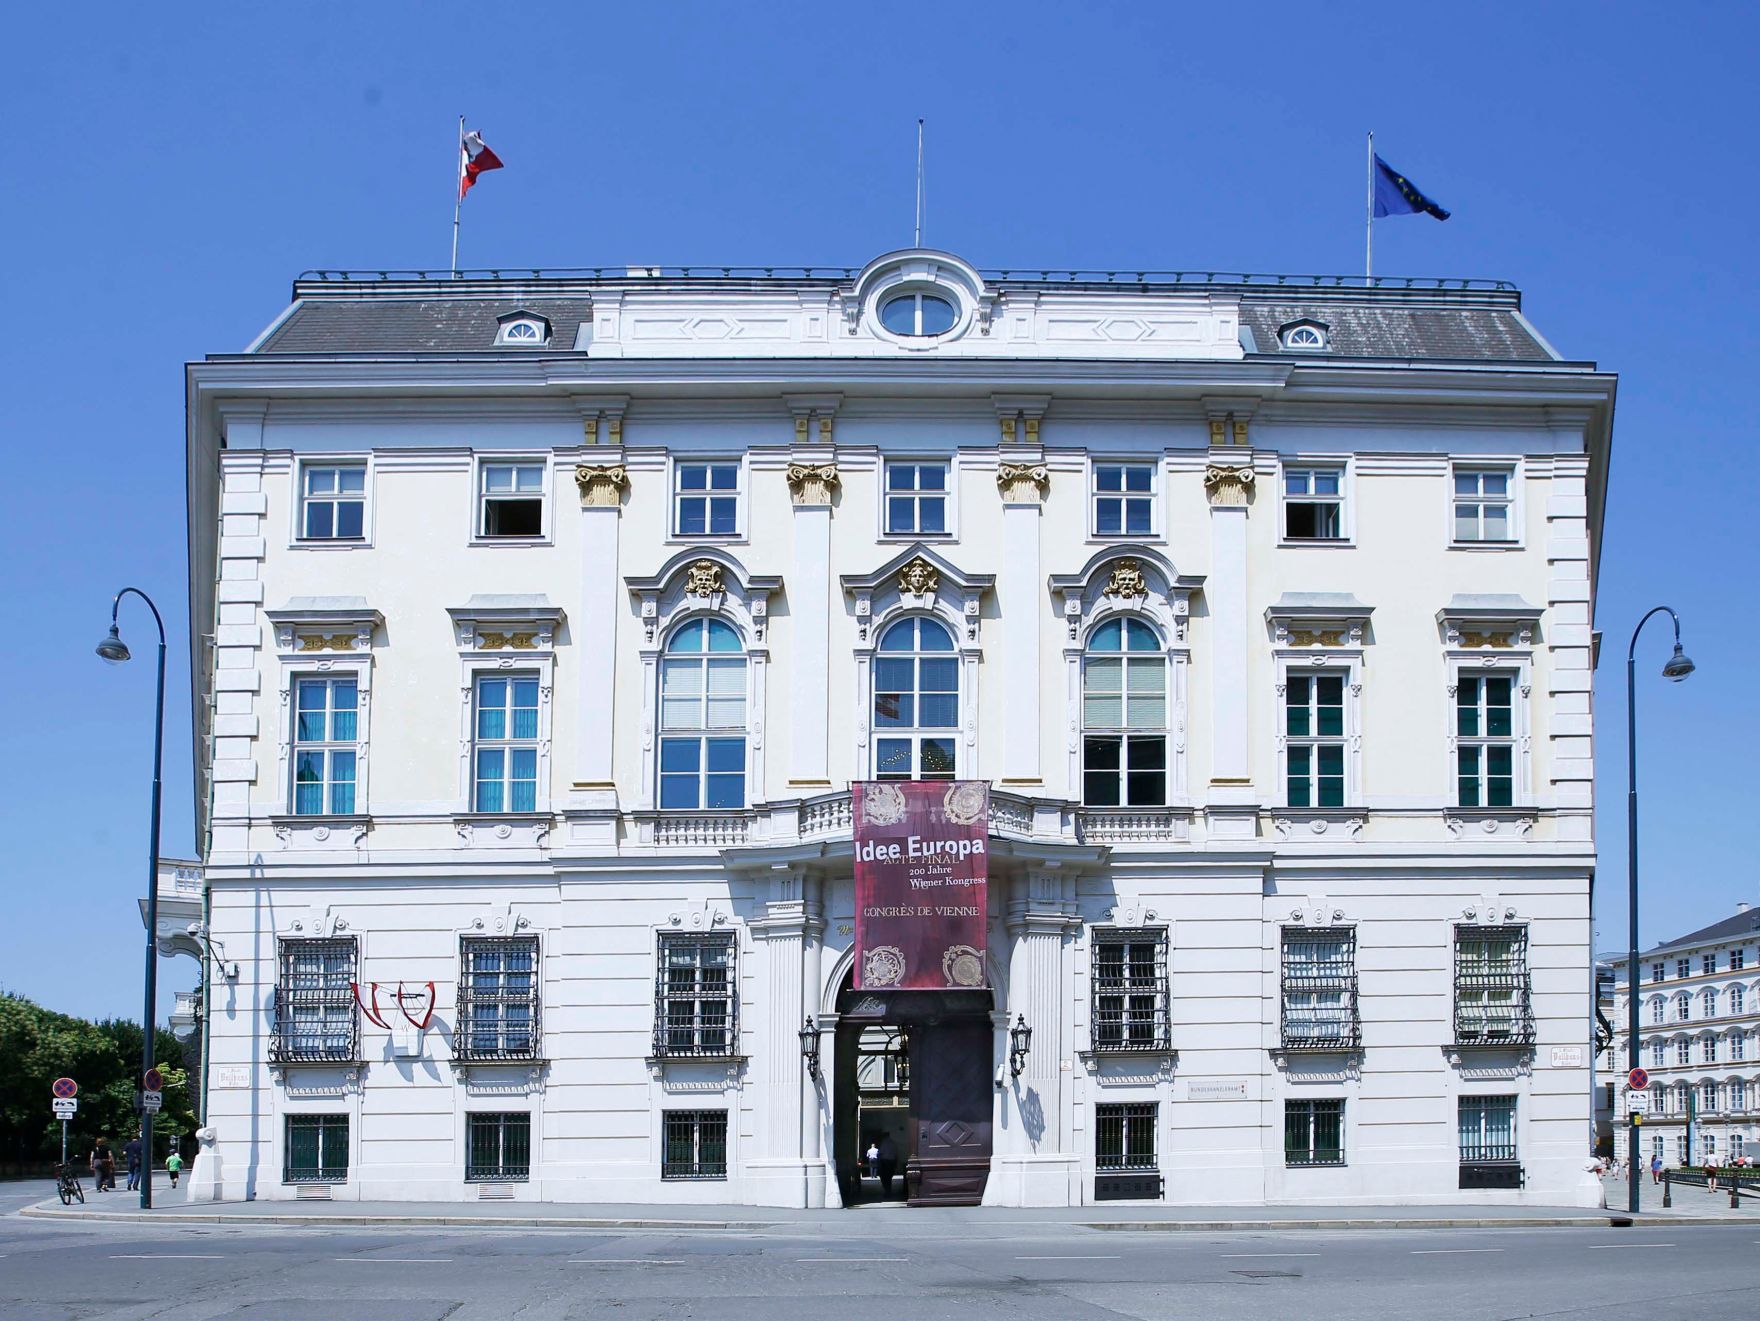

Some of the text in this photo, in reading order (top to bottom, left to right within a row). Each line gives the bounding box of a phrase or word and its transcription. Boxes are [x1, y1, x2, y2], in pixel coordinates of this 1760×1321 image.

[855, 836, 984, 862] Idee Europa
[921, 854, 960, 865] FINAL
[909, 865, 953, 876] 200 Jahre
[909, 878, 944, 888] Wiener
[946, 876, 986, 887] Kongress
[864, 903, 980, 916] CONGRÈS DE VIENNE
